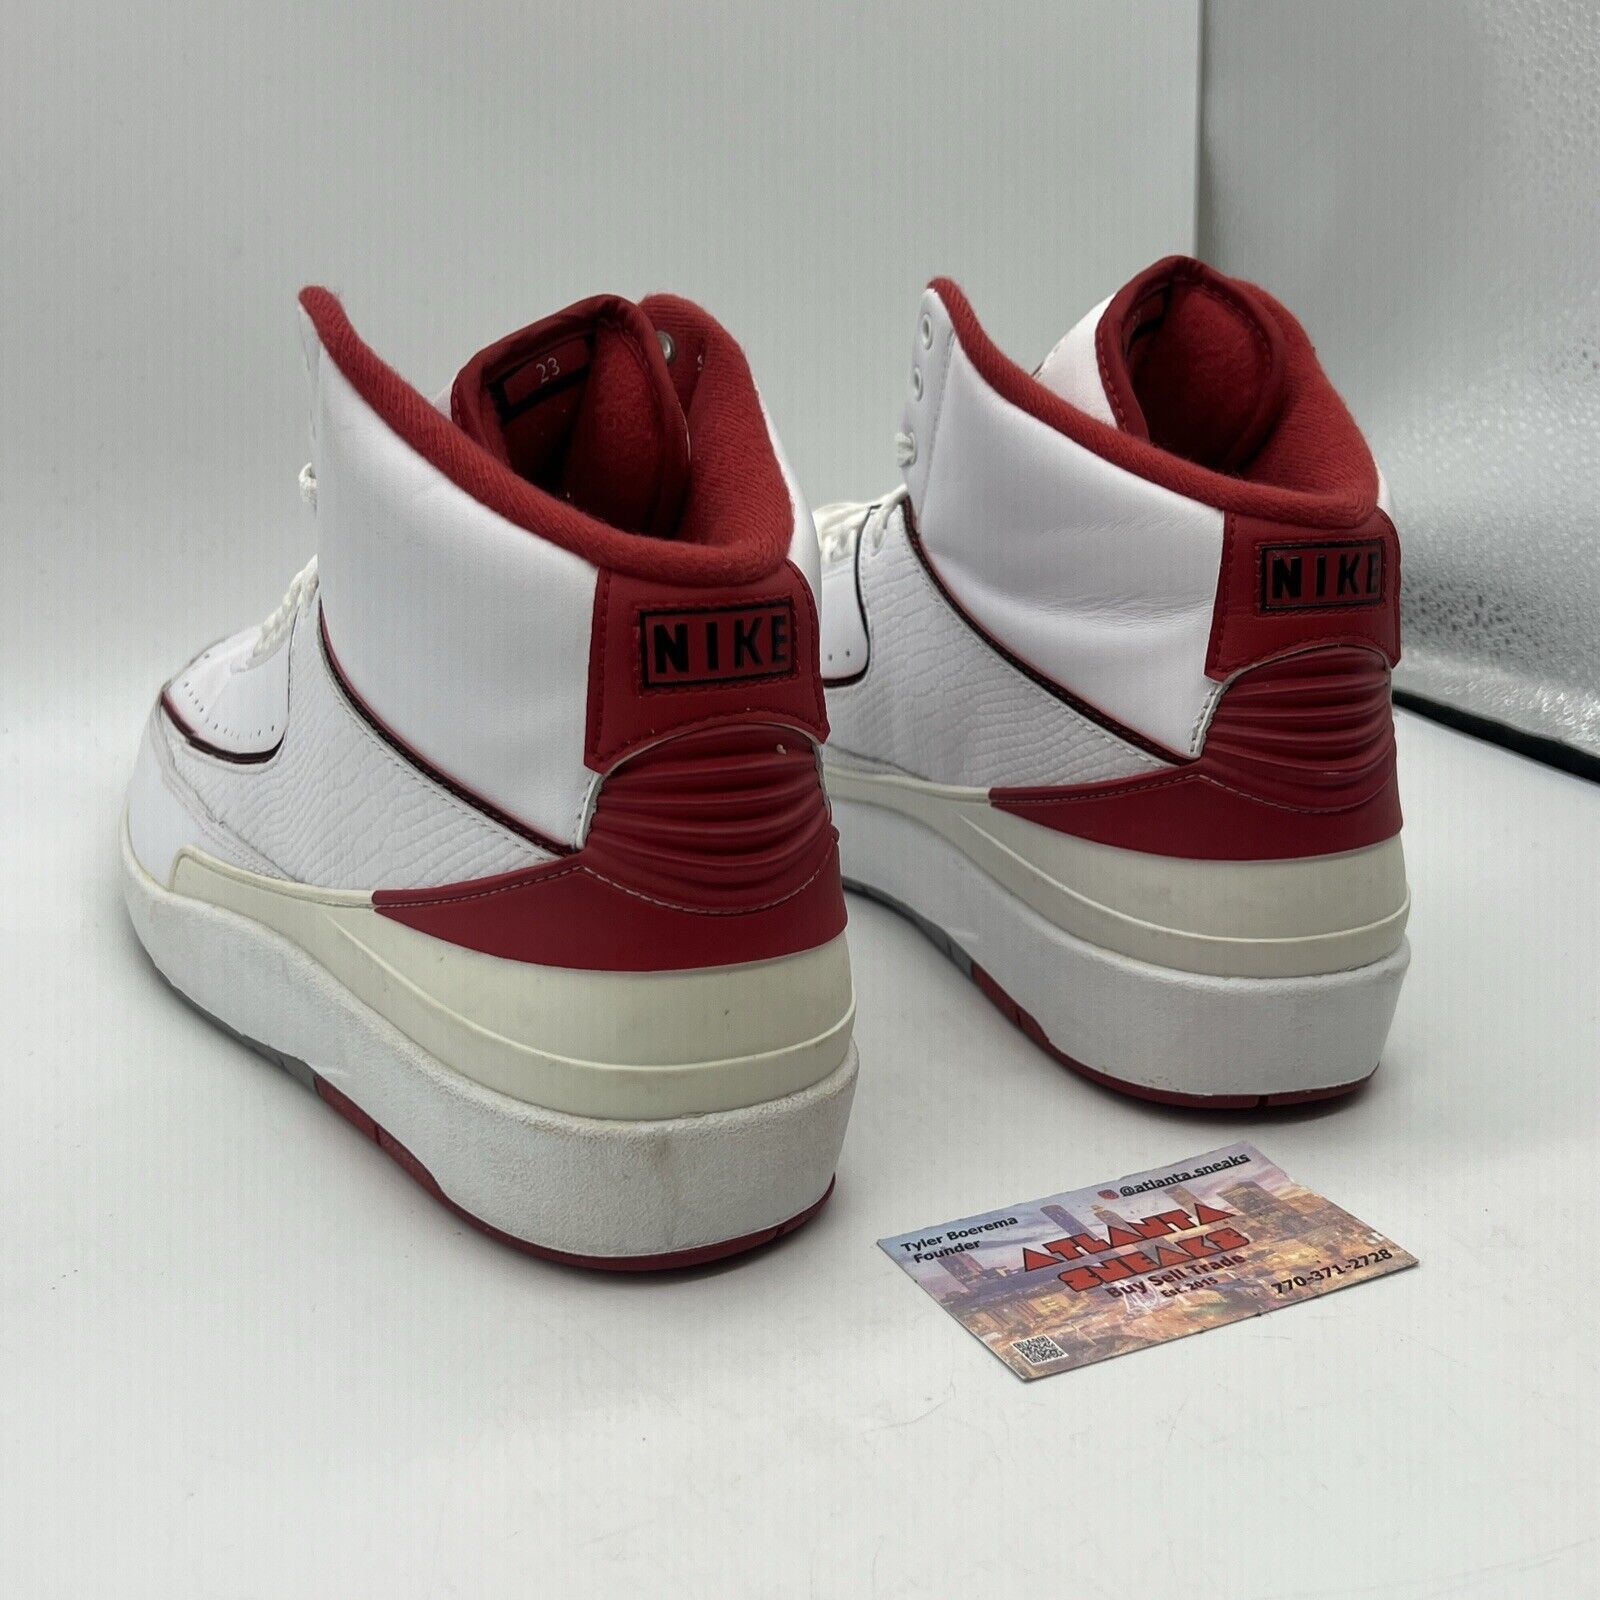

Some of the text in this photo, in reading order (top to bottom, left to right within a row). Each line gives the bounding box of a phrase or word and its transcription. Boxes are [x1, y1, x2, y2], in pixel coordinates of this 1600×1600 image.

[536, 357, 561, 383] 23
[1272, 553, 1380, 599] NIKE
[653, 614, 788, 674] NIKE
[1119, 1152, 1251, 1197] @atlanta.sneaks
[901, 1215, 1019, 1253] Tyler Boerema
[913, 1239, 981, 1264] Founder
[1022, 1202, 1236, 1272] ATLANTA
[1057, 1226, 1250, 1293] SNEAKS
[1105, 1253, 1247, 1299] Buy Sell Trade
[1270, 1248, 1393, 1295] 770-371-2728
[1161, 1276, 1219, 1299] Est. 2015
